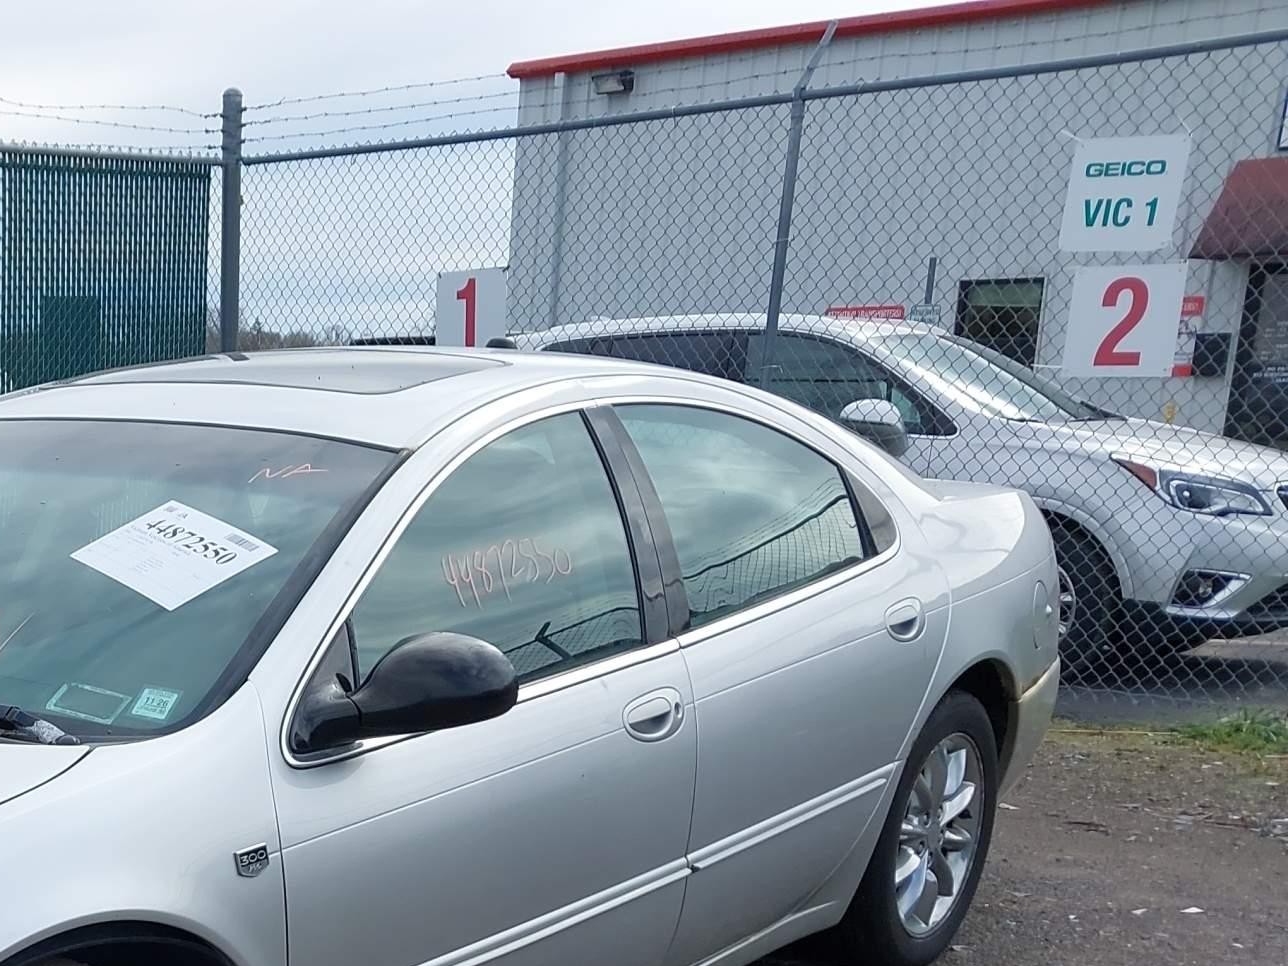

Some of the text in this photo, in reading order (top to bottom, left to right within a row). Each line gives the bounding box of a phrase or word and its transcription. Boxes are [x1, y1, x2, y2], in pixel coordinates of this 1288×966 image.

[1085, 159, 1167, 178] GEICO
[1083, 196, 1159, 228] VIC 1
[456, 277, 476, 348] 1
[1093, 276, 1150, 367] 2
[247, 463, 330, 484] NA
[145, 518, 239, 566] 44872550
[440, 538, 573, 611] 44872550
[240, 849, 267, 866] 300
